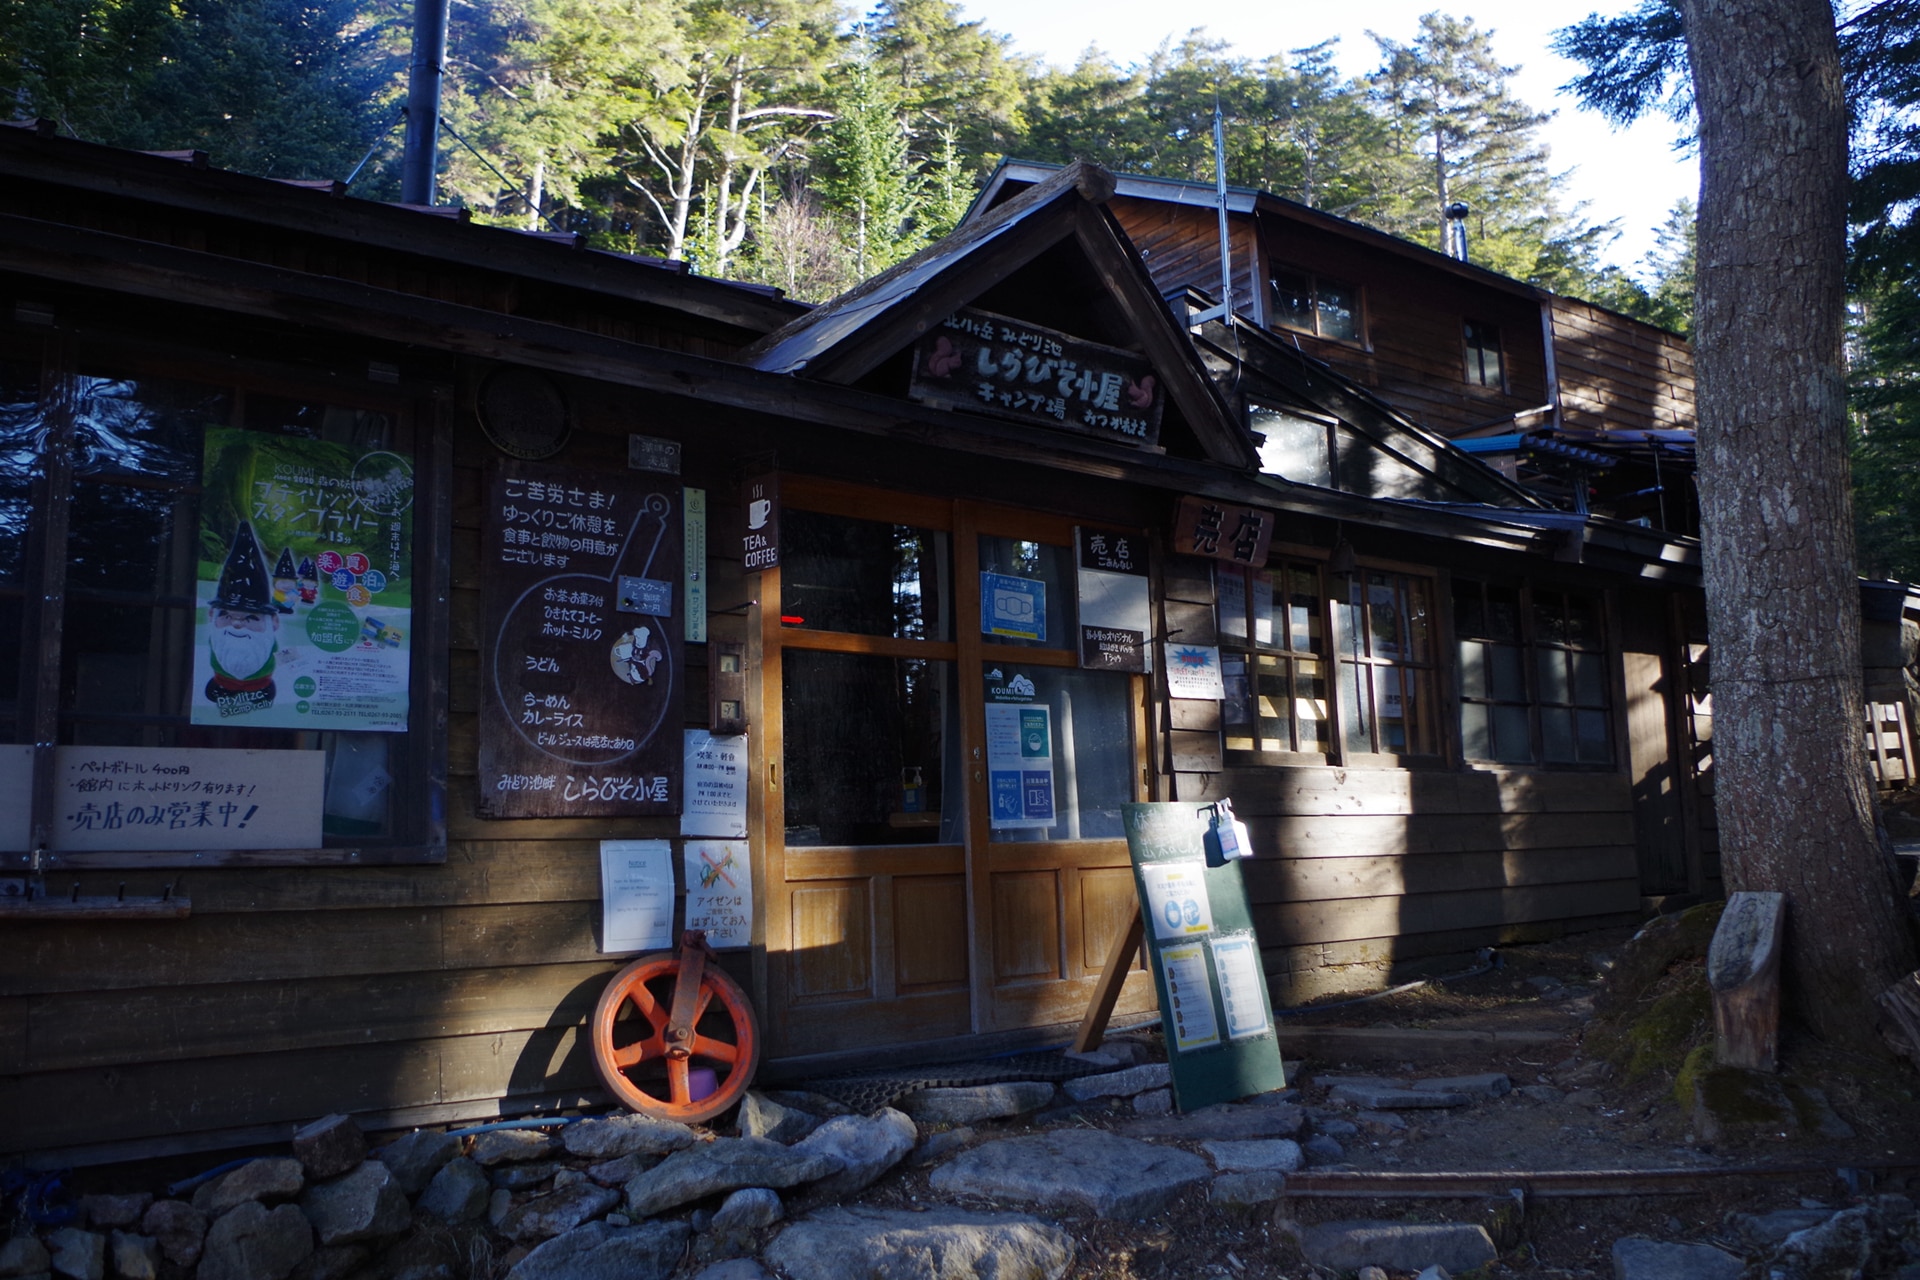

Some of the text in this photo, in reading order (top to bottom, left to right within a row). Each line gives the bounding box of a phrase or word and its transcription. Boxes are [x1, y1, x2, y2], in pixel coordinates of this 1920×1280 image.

[1001, 326, 1063, 358] みどり池
[977, 346, 1123, 412] しらびそ小屋
[977, 382, 1067, 421] キャンプ場
[274, 463, 315, 477] KOUMI
[293, 476, 315, 486] 2020
[505, 478, 617, 510] ご苦労さま!
[253, 501, 380, 531] スタンプラリー
[502, 527, 619, 557] 食事と飲物の用意が
[1193, 504, 1264, 563] 売店
[1089, 534, 1130, 558] 売店
[501, 547, 570, 569] ございます
[744, 547, 777, 569] COFFEE
[1097, 556, 1134, 571] ごあんない
[624, 579, 668, 594] チーズケーキ
[543, 605, 603, 624] ひきたてコーヒー
[525, 655, 560, 674] うどん
[523, 691, 571, 710] らーめん
[991, 687, 1015, 696] KOUMI
[521, 709, 584, 728] カレーライス
[537, 731, 557, 746] ビール
[496, 774, 669, 803] みどり池畔 しらびそ小屋
[697, 896, 742, 907] アイゼンは
